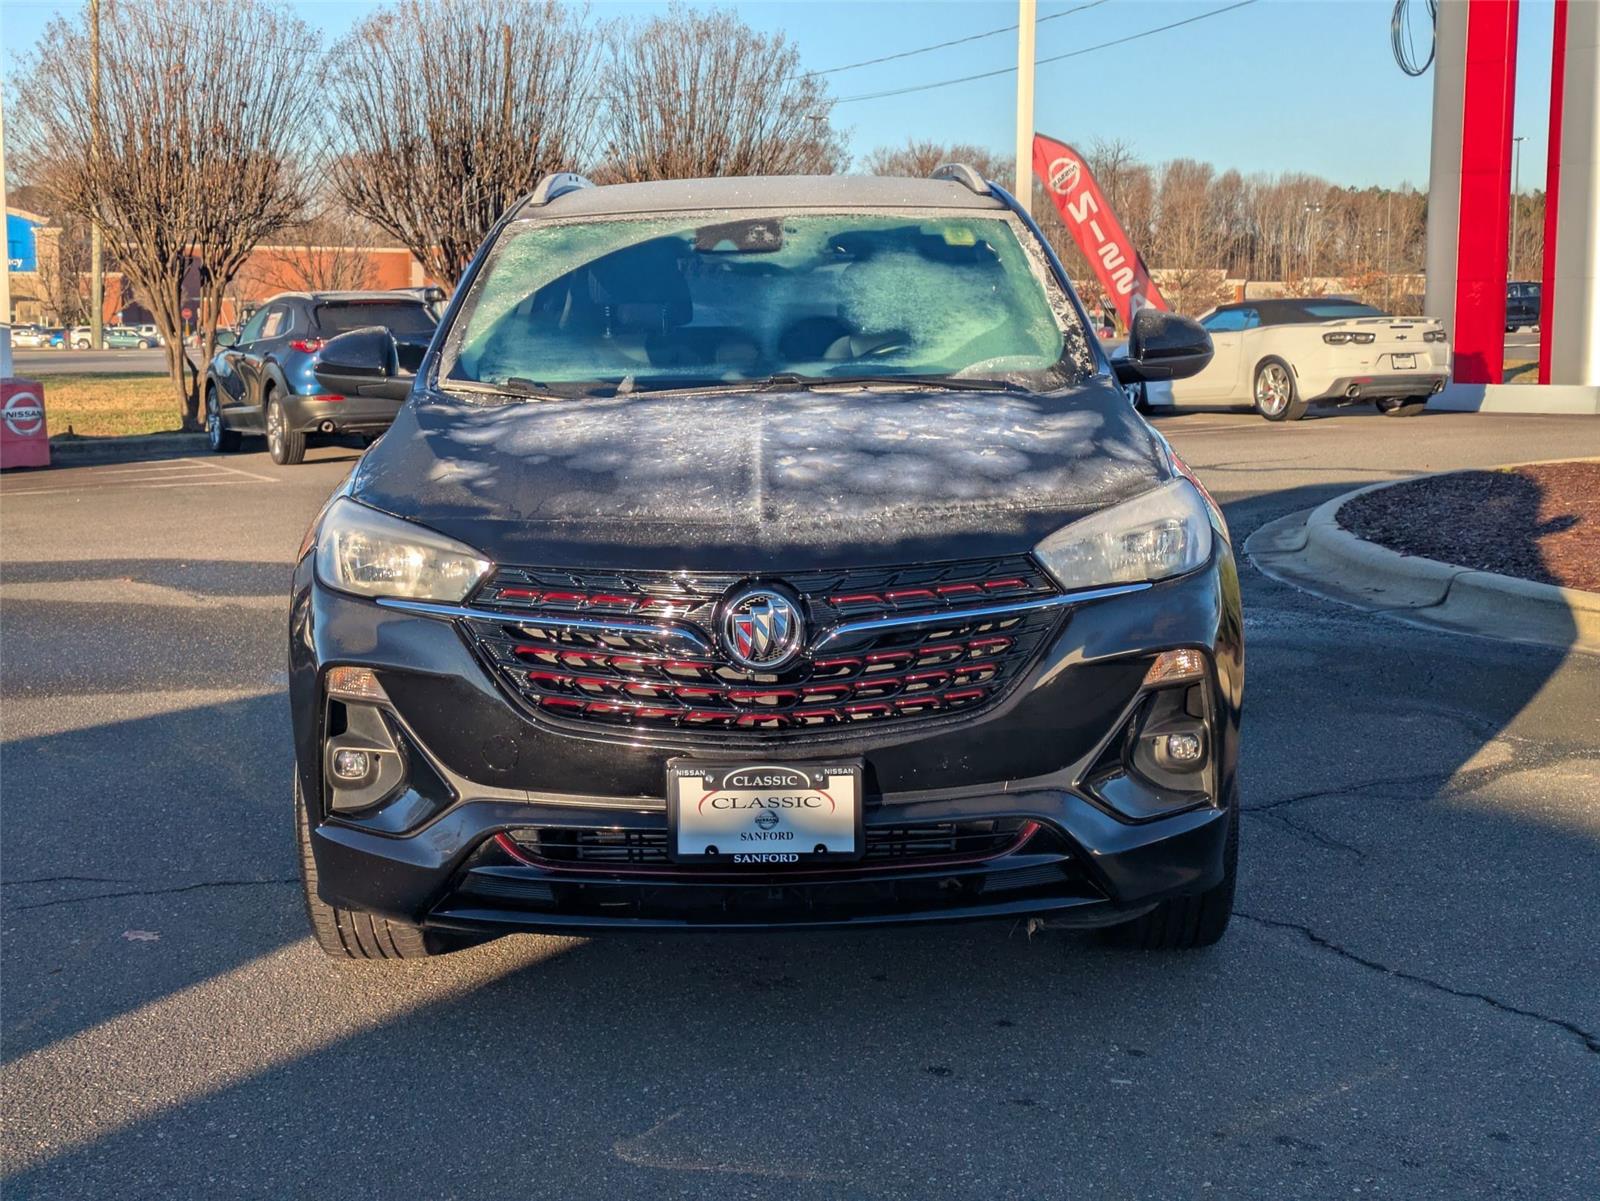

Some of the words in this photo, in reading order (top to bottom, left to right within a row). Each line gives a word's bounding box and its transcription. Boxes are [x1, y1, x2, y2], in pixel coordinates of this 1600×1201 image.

[733, 776, 797, 786] CLASSIC
[712, 796, 821, 809] CLASSIC
[740, 831, 794, 841] SANFORD
[733, 853, 799, 863] SANFORD
